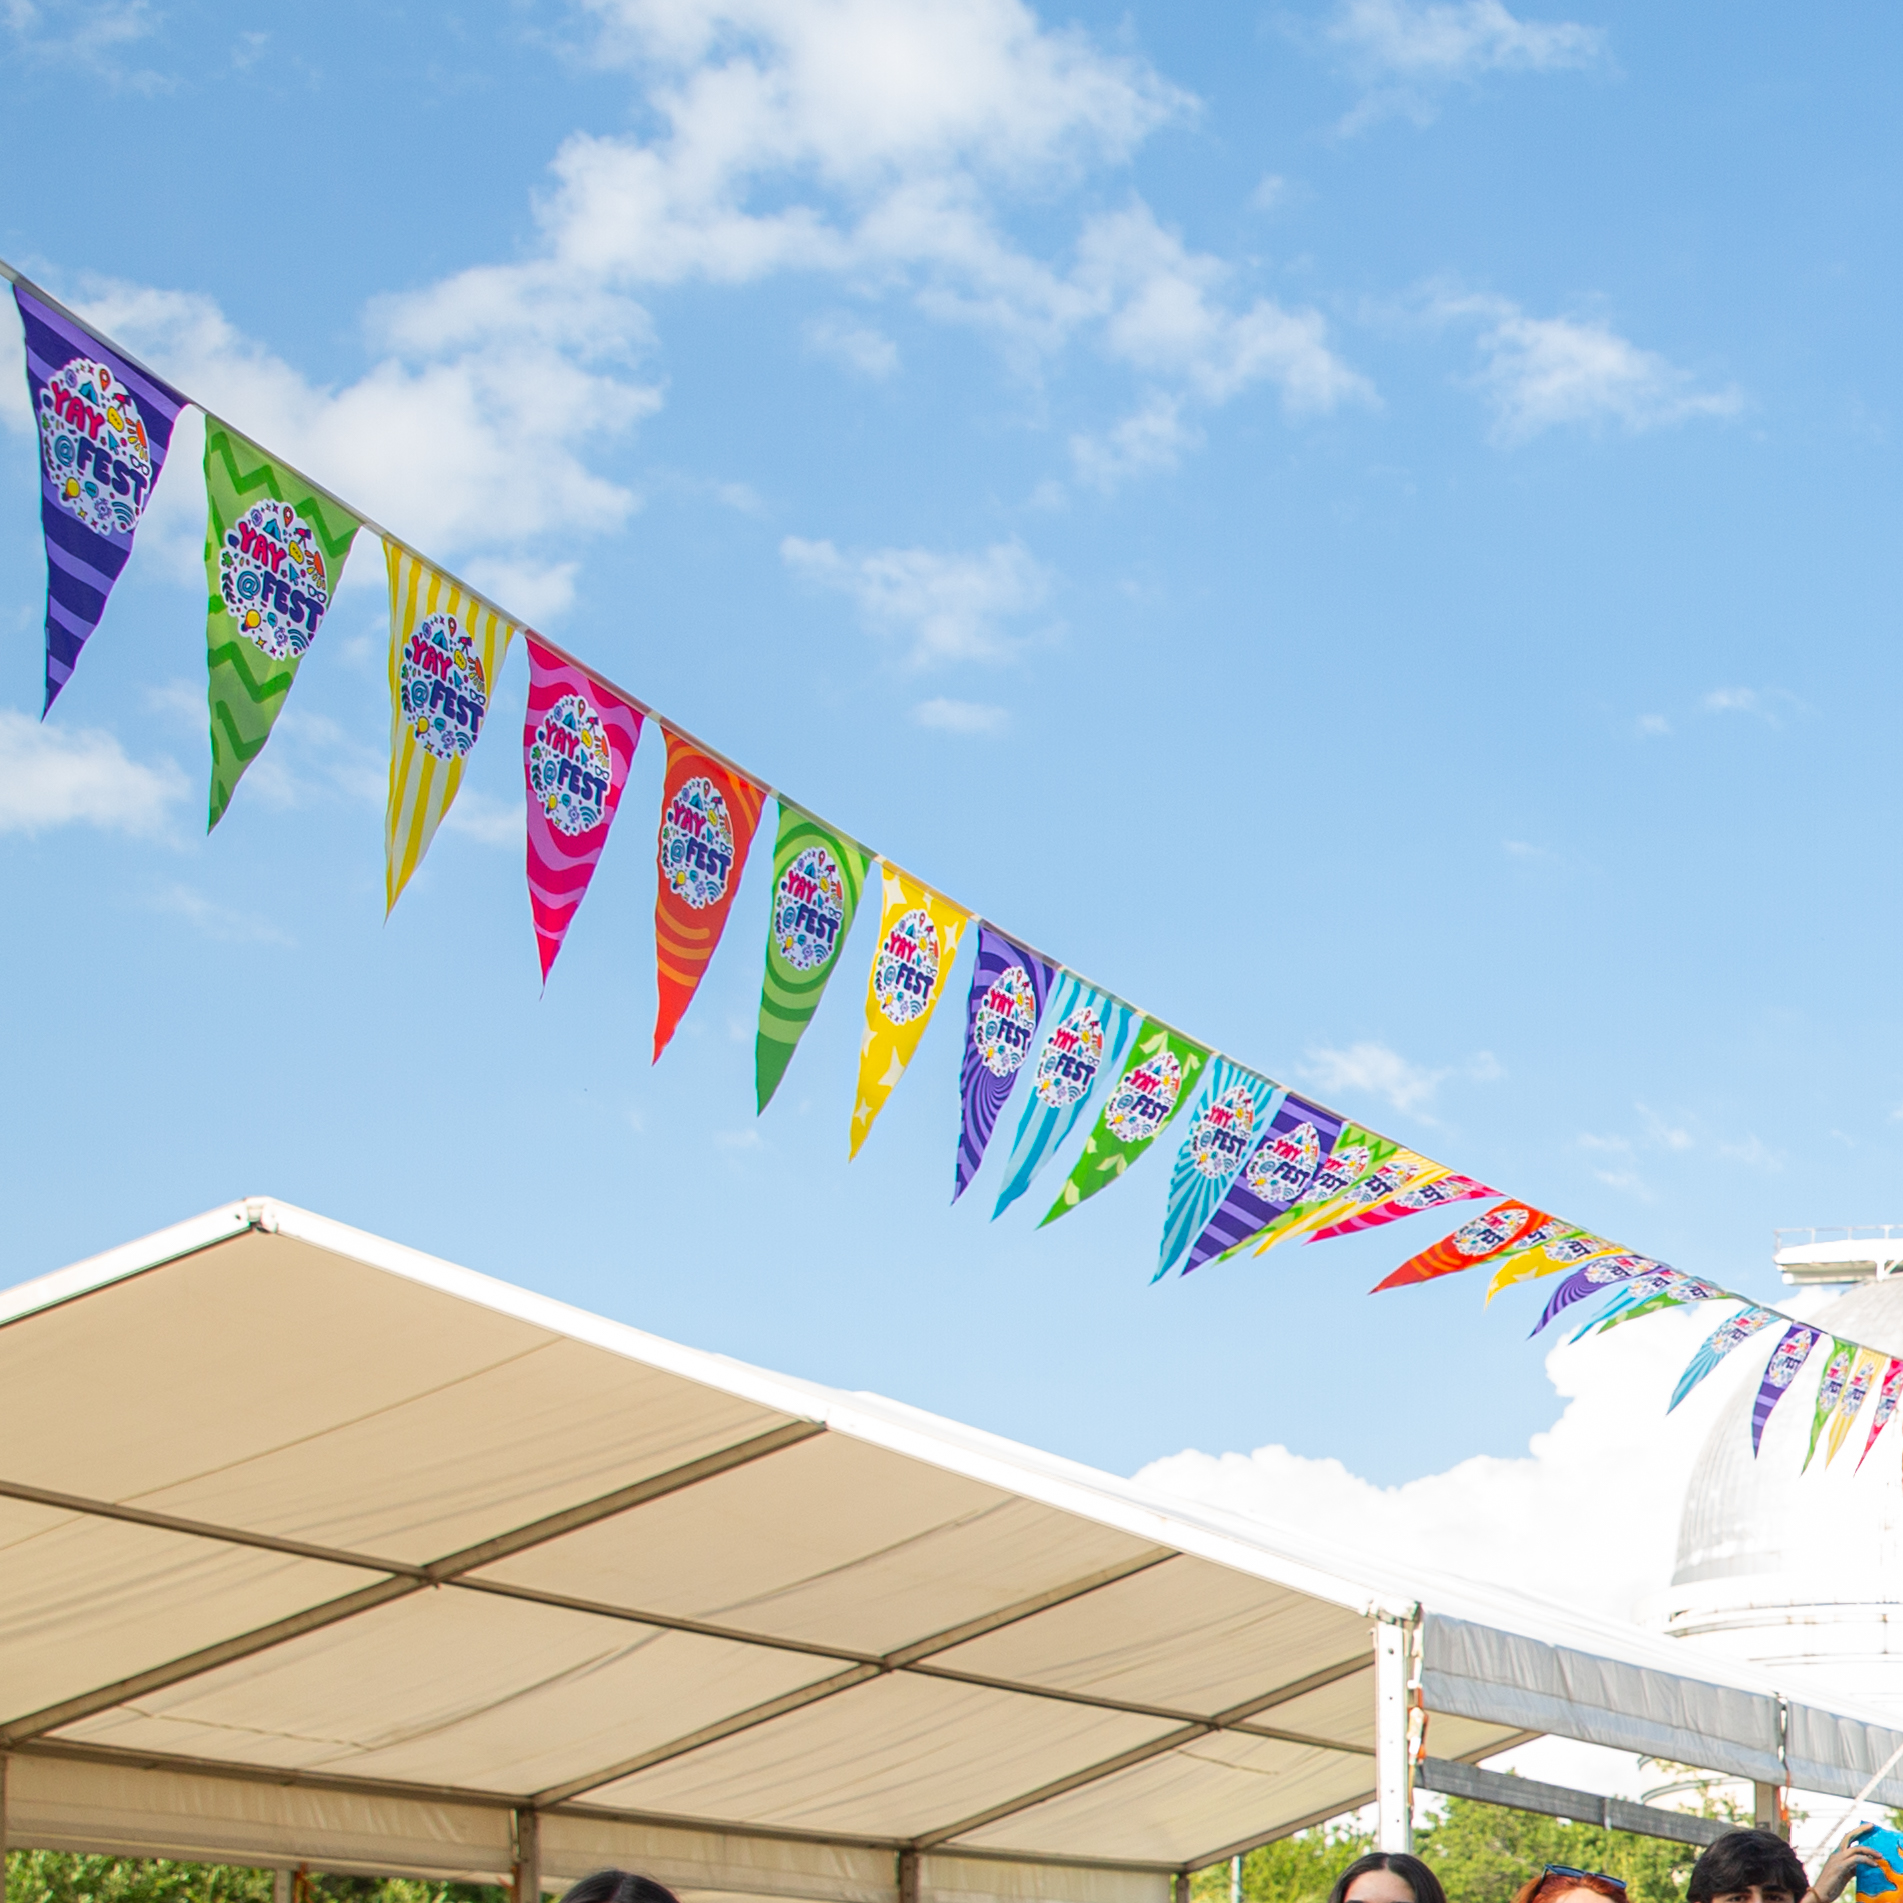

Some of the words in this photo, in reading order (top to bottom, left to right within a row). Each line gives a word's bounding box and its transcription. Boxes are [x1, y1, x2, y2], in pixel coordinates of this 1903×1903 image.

[53, 370, 105, 439] YAY
[238, 520, 288, 574] YAY
[406, 636, 452, 684] YAY
[544, 718, 582, 758] YAY
[672, 801, 705, 836] YAY
[787, 869, 818, 902] YAY
[889, 931, 917, 962] YAY
[990, 987, 1017, 1017] YAY
[1055, 1026, 1079, 1053] YAY
[1129, 1069, 1158, 1094] YAY
[1210, 1105, 1234, 1128] YAY
[1274, 1140, 1302, 1161] YAY
